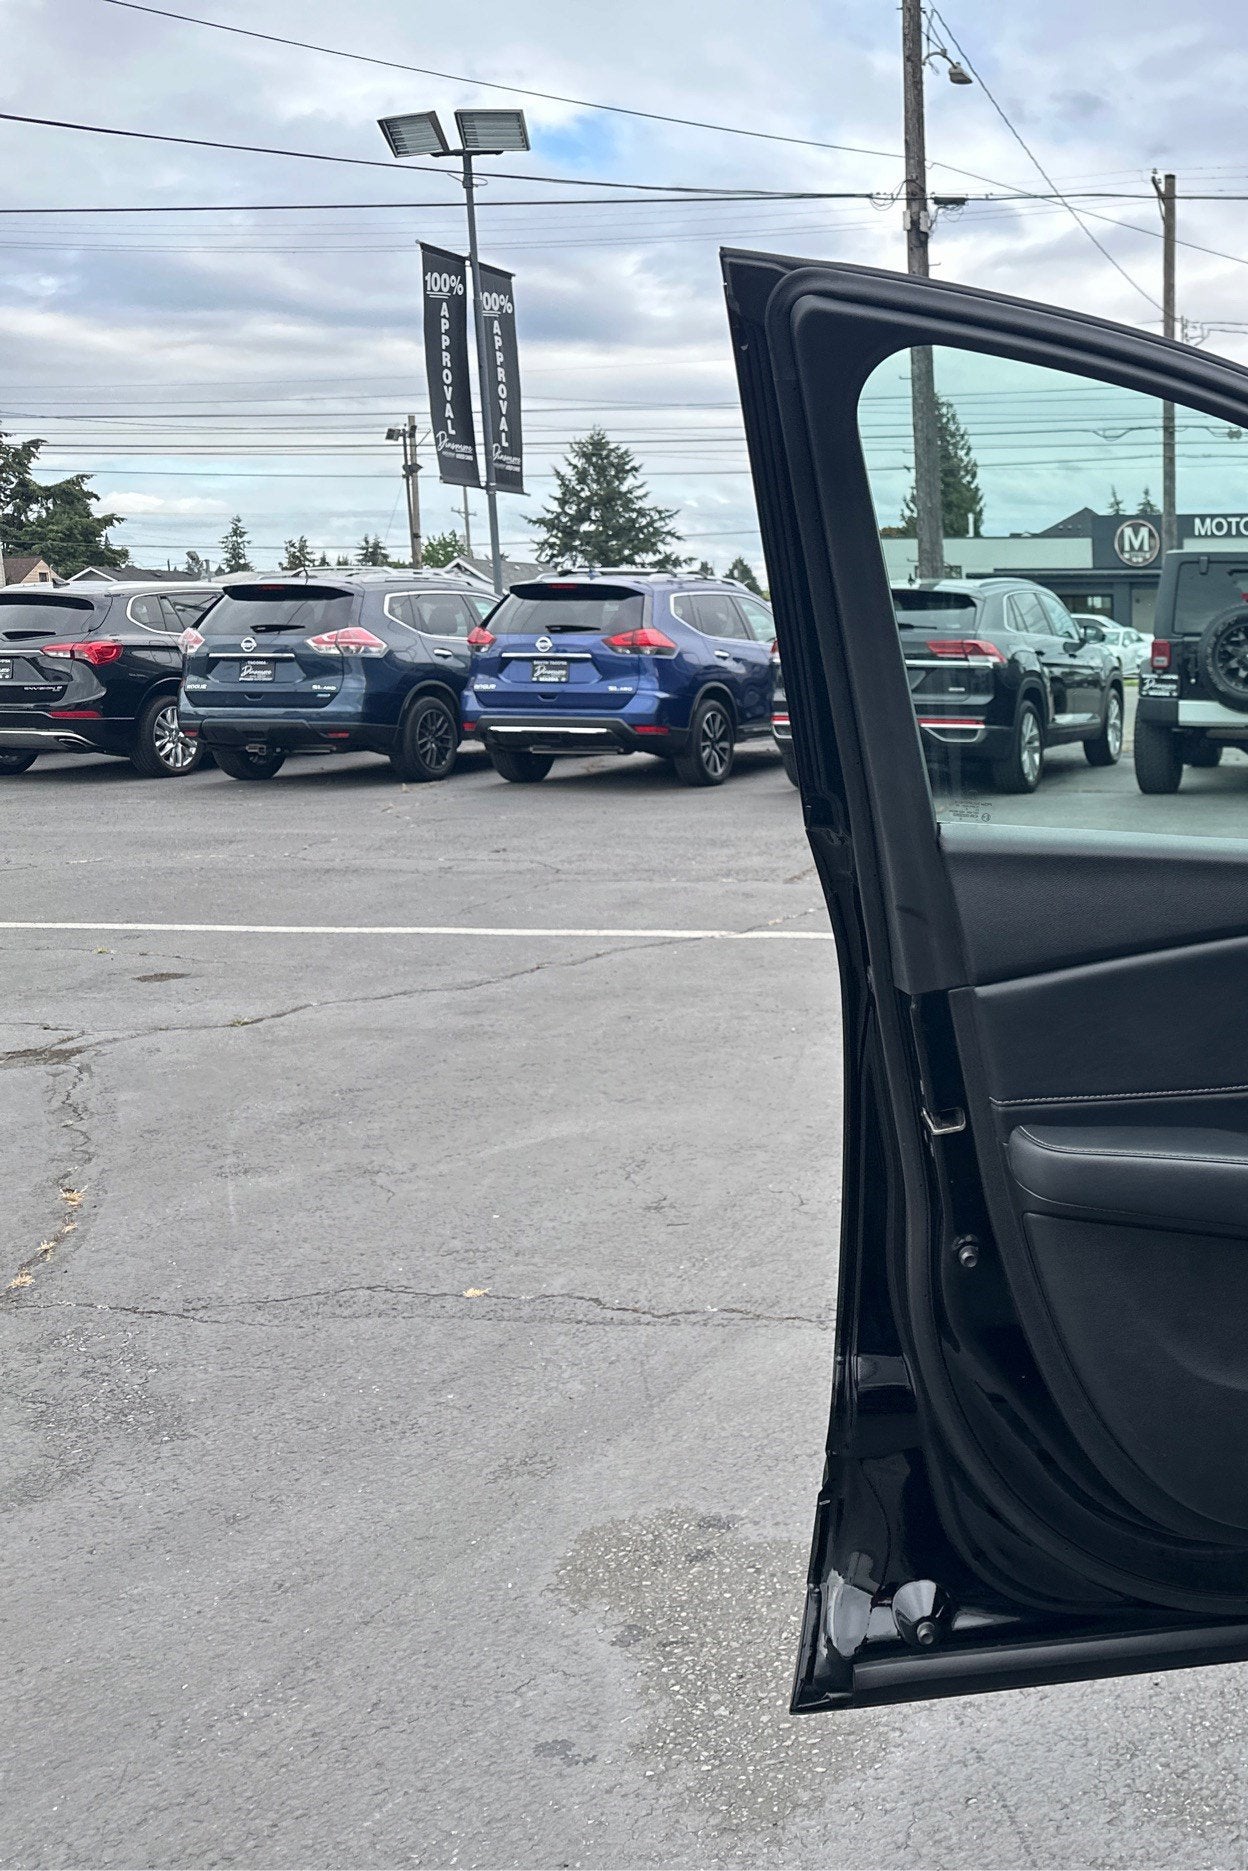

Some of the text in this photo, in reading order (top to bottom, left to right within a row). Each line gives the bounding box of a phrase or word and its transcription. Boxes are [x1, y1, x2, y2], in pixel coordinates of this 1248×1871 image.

[425, 272, 464, 295] 100%
[440, 302, 455, 435] APPROVAL
[493, 320, 508, 447] APPROVAL
[1123, 527, 1149, 551] M
